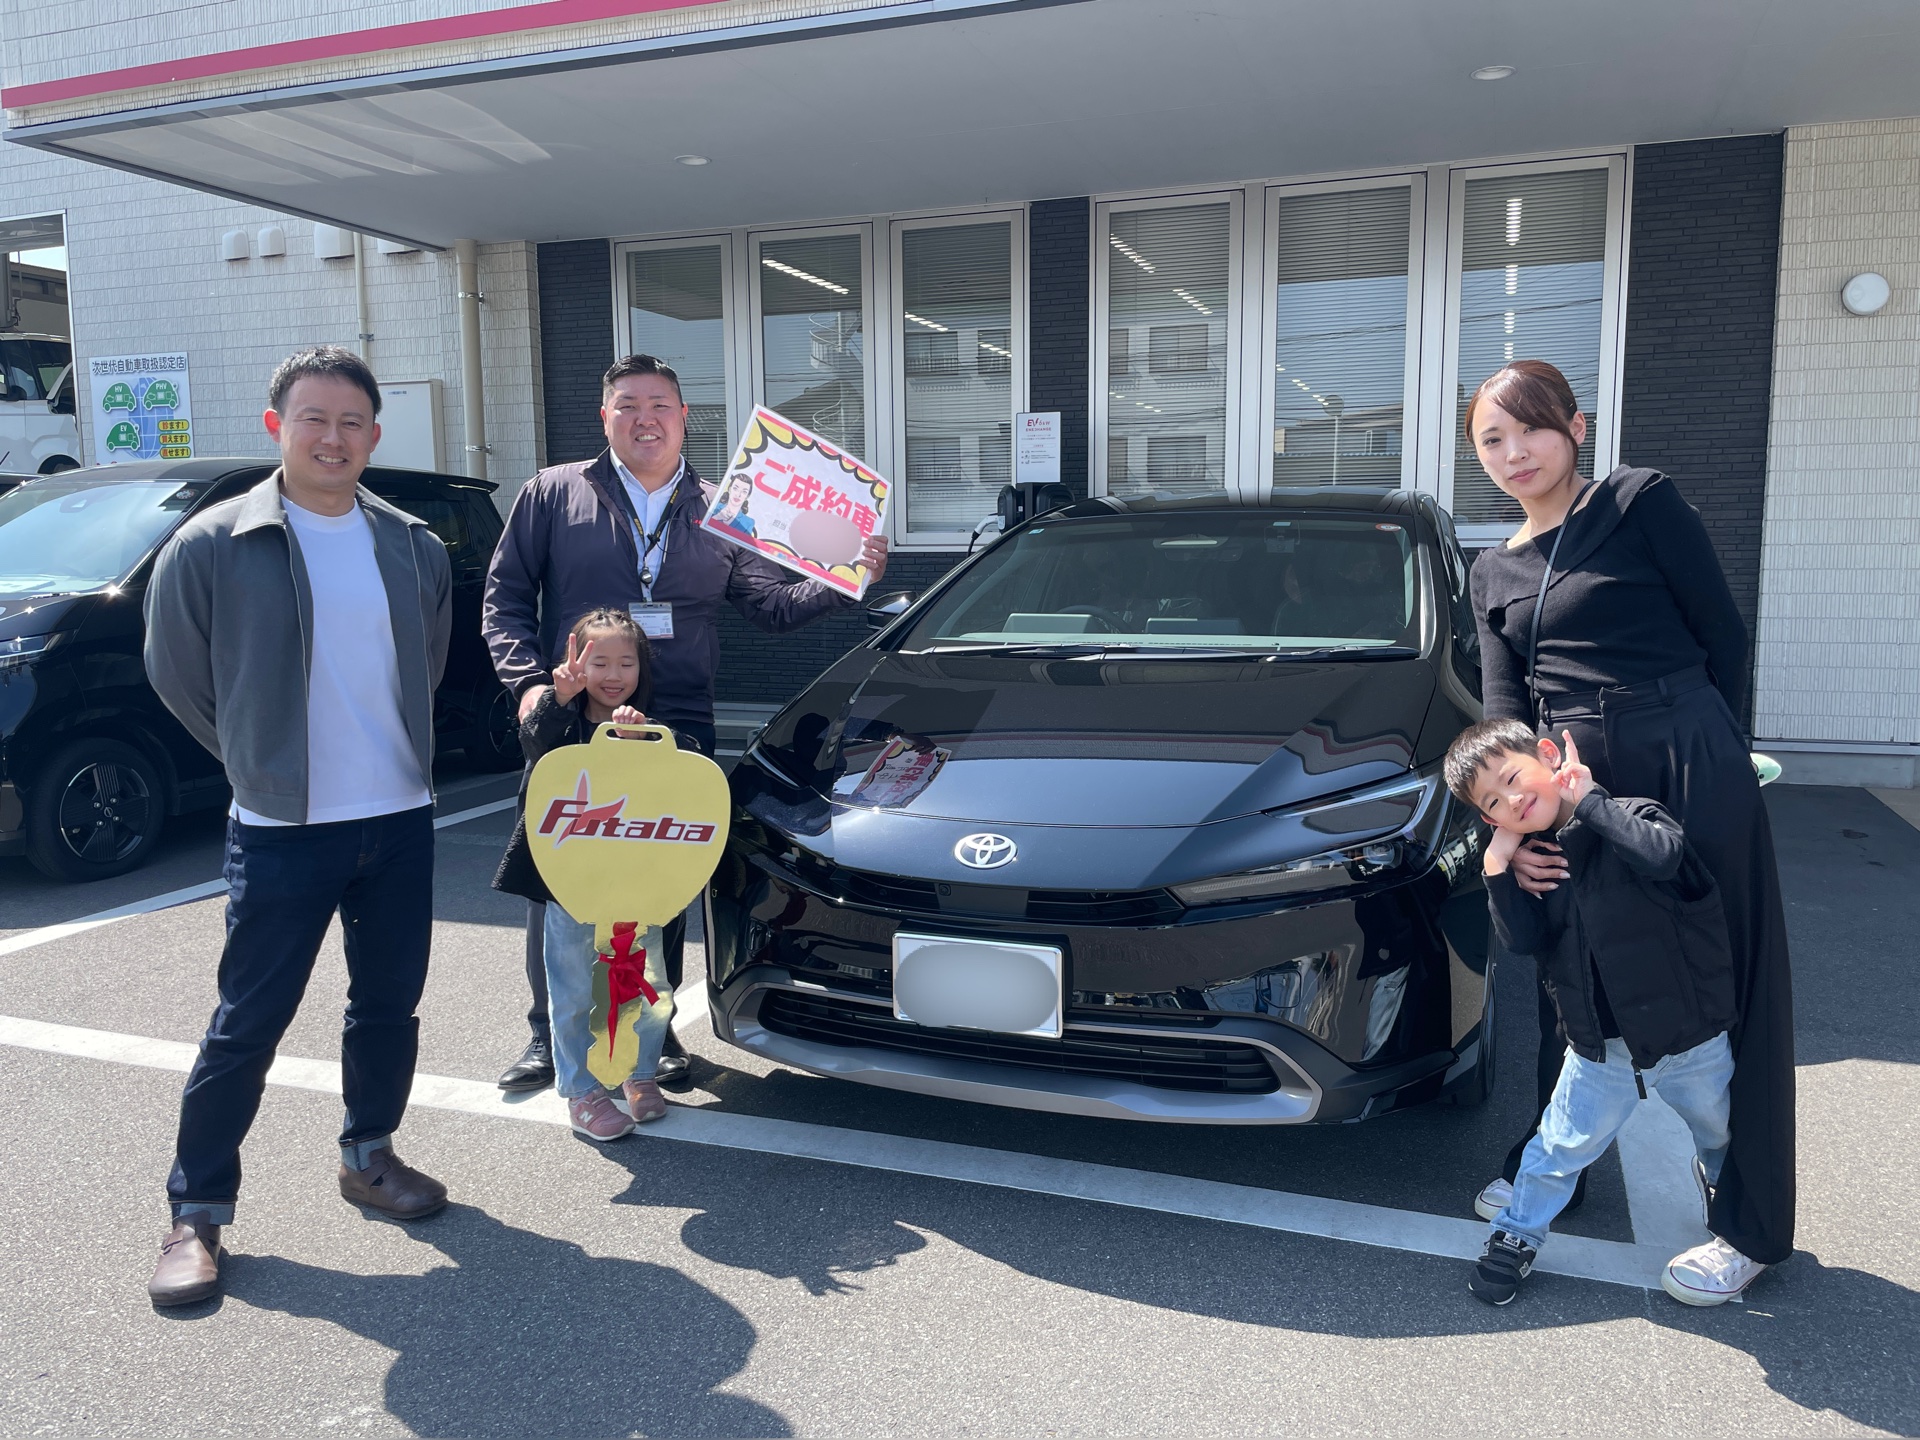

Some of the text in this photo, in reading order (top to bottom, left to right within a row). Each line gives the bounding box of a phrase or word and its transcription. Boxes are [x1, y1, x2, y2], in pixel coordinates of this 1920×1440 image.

[92, 356, 187, 375] 次世代自動車取扱認定店
[754, 458, 877, 540] ご成約車
[539, 799, 716, 843] Futaba
